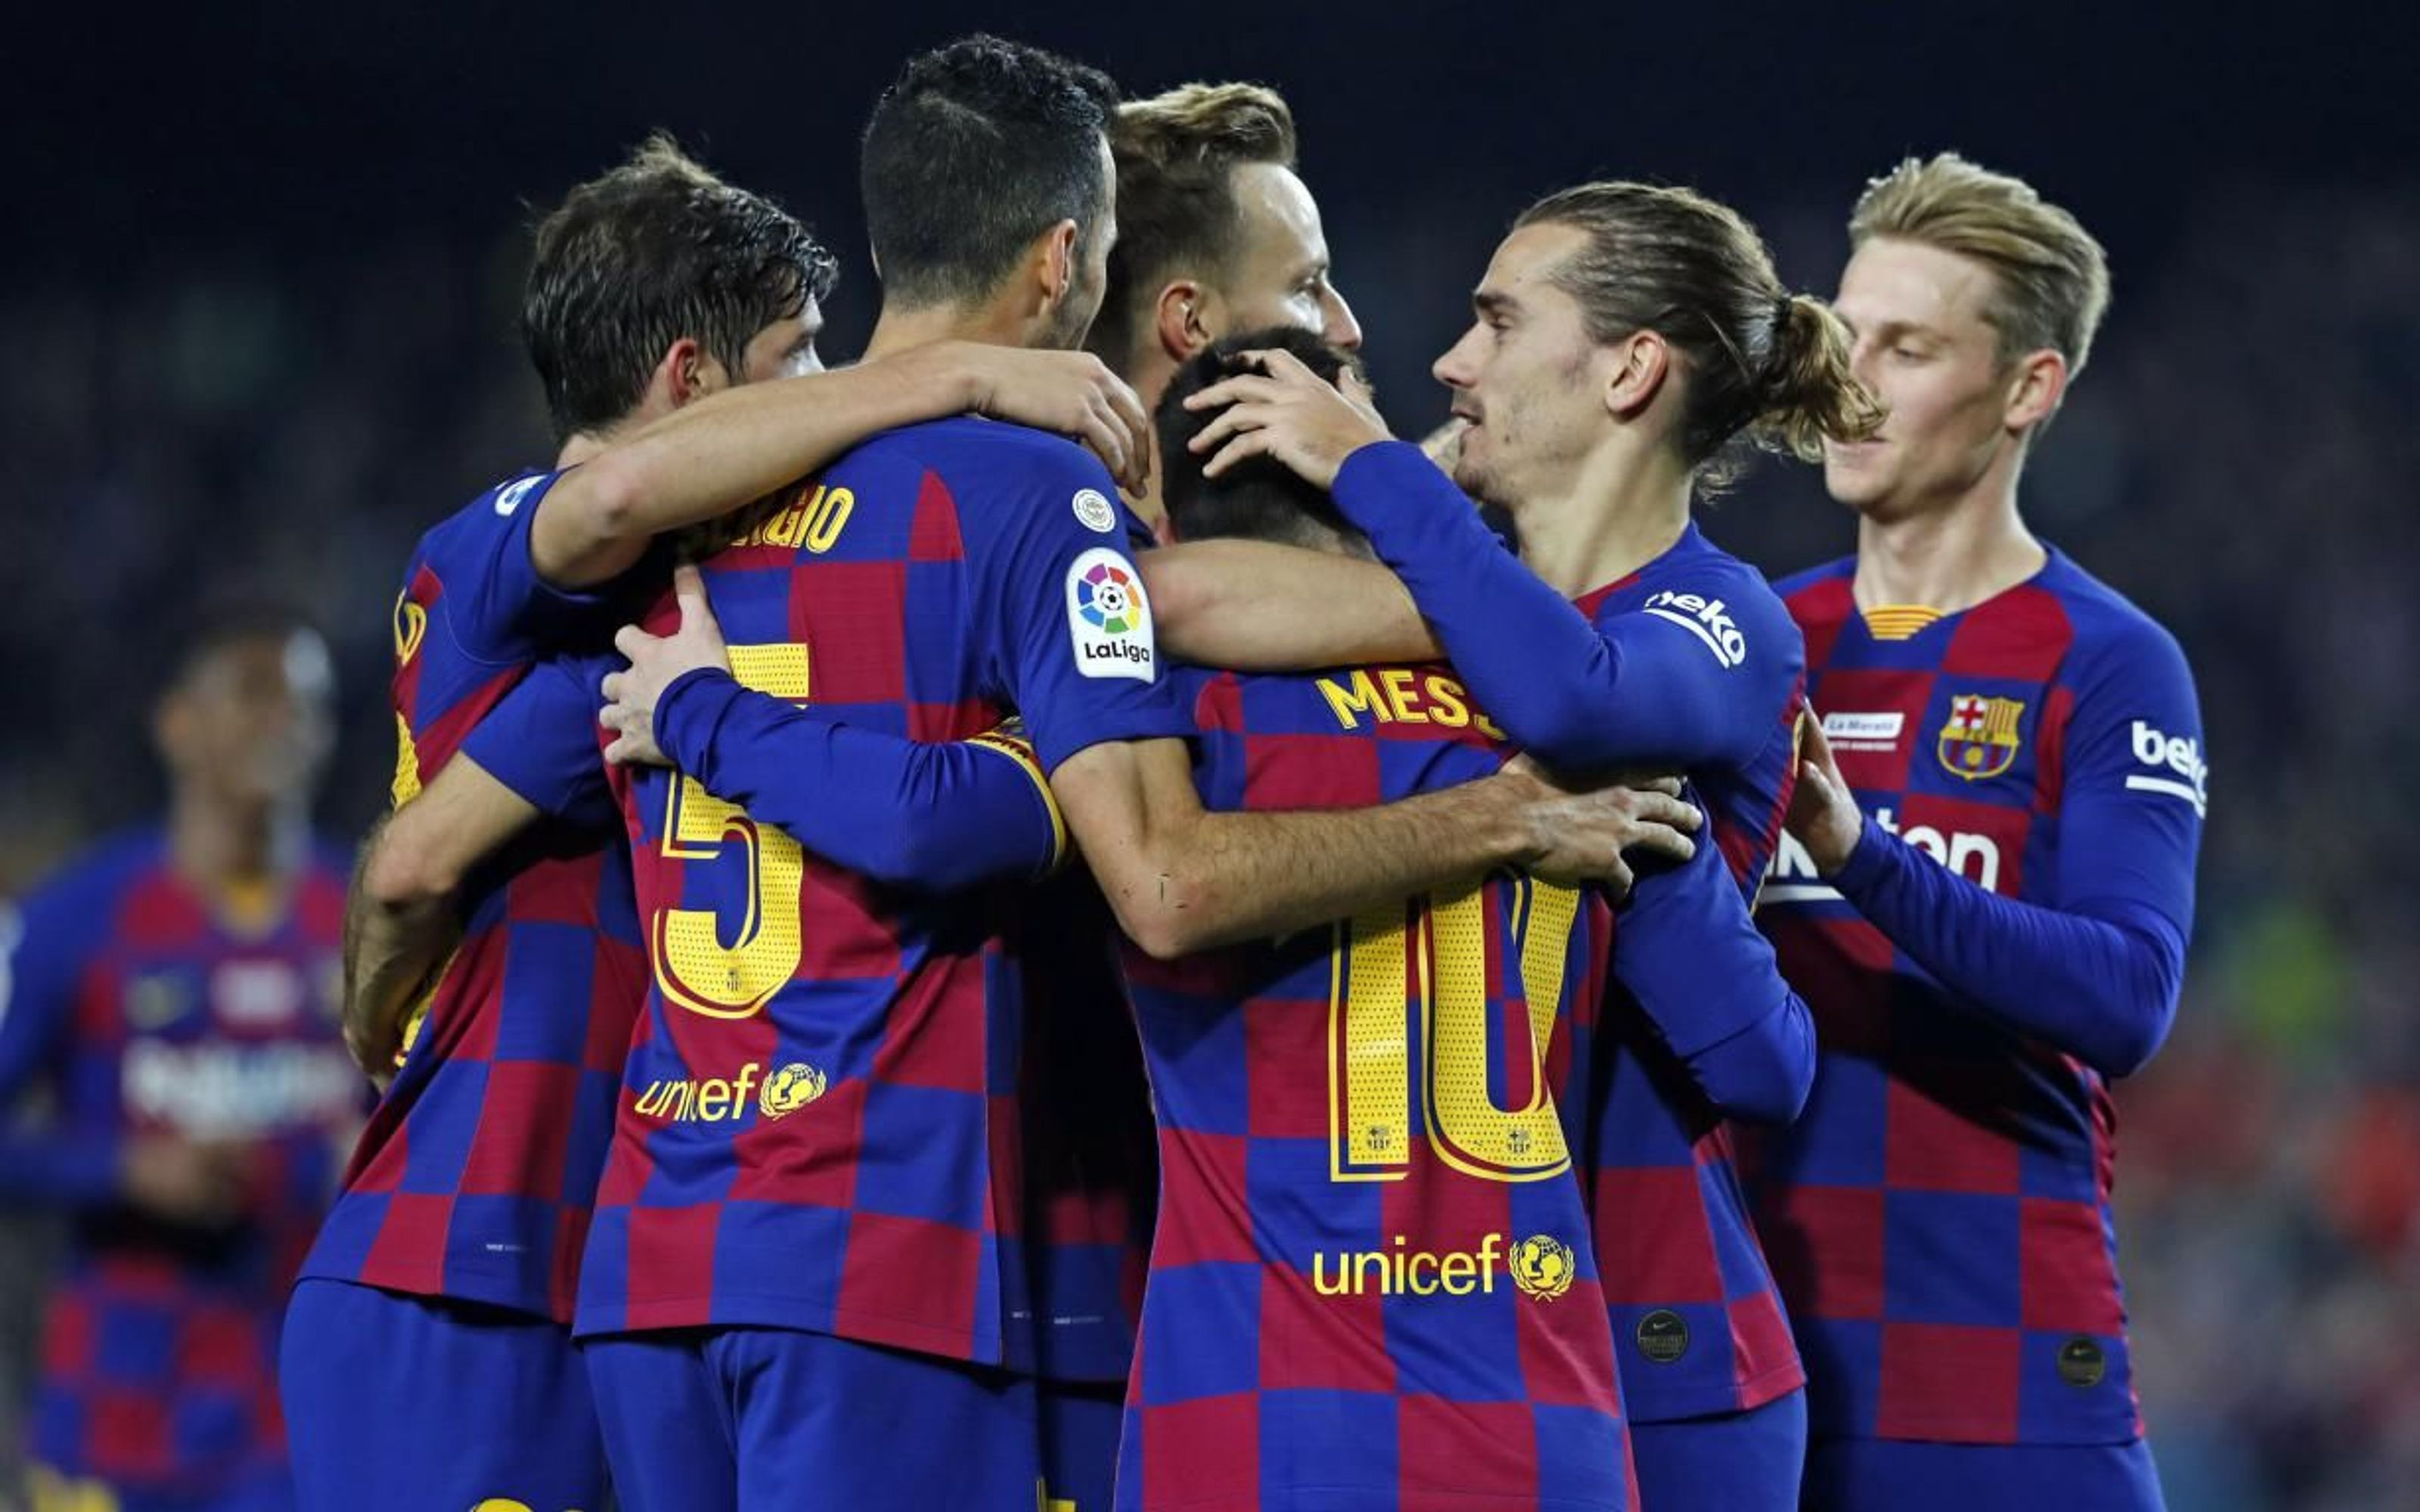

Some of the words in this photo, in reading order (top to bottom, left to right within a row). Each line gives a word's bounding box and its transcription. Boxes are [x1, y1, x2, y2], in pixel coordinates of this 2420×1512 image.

[1084, 640, 1150, 662] LaLiga
[1328, 875, 1580, 1182] 10
[1314, 1233, 1500, 1295] unicef
